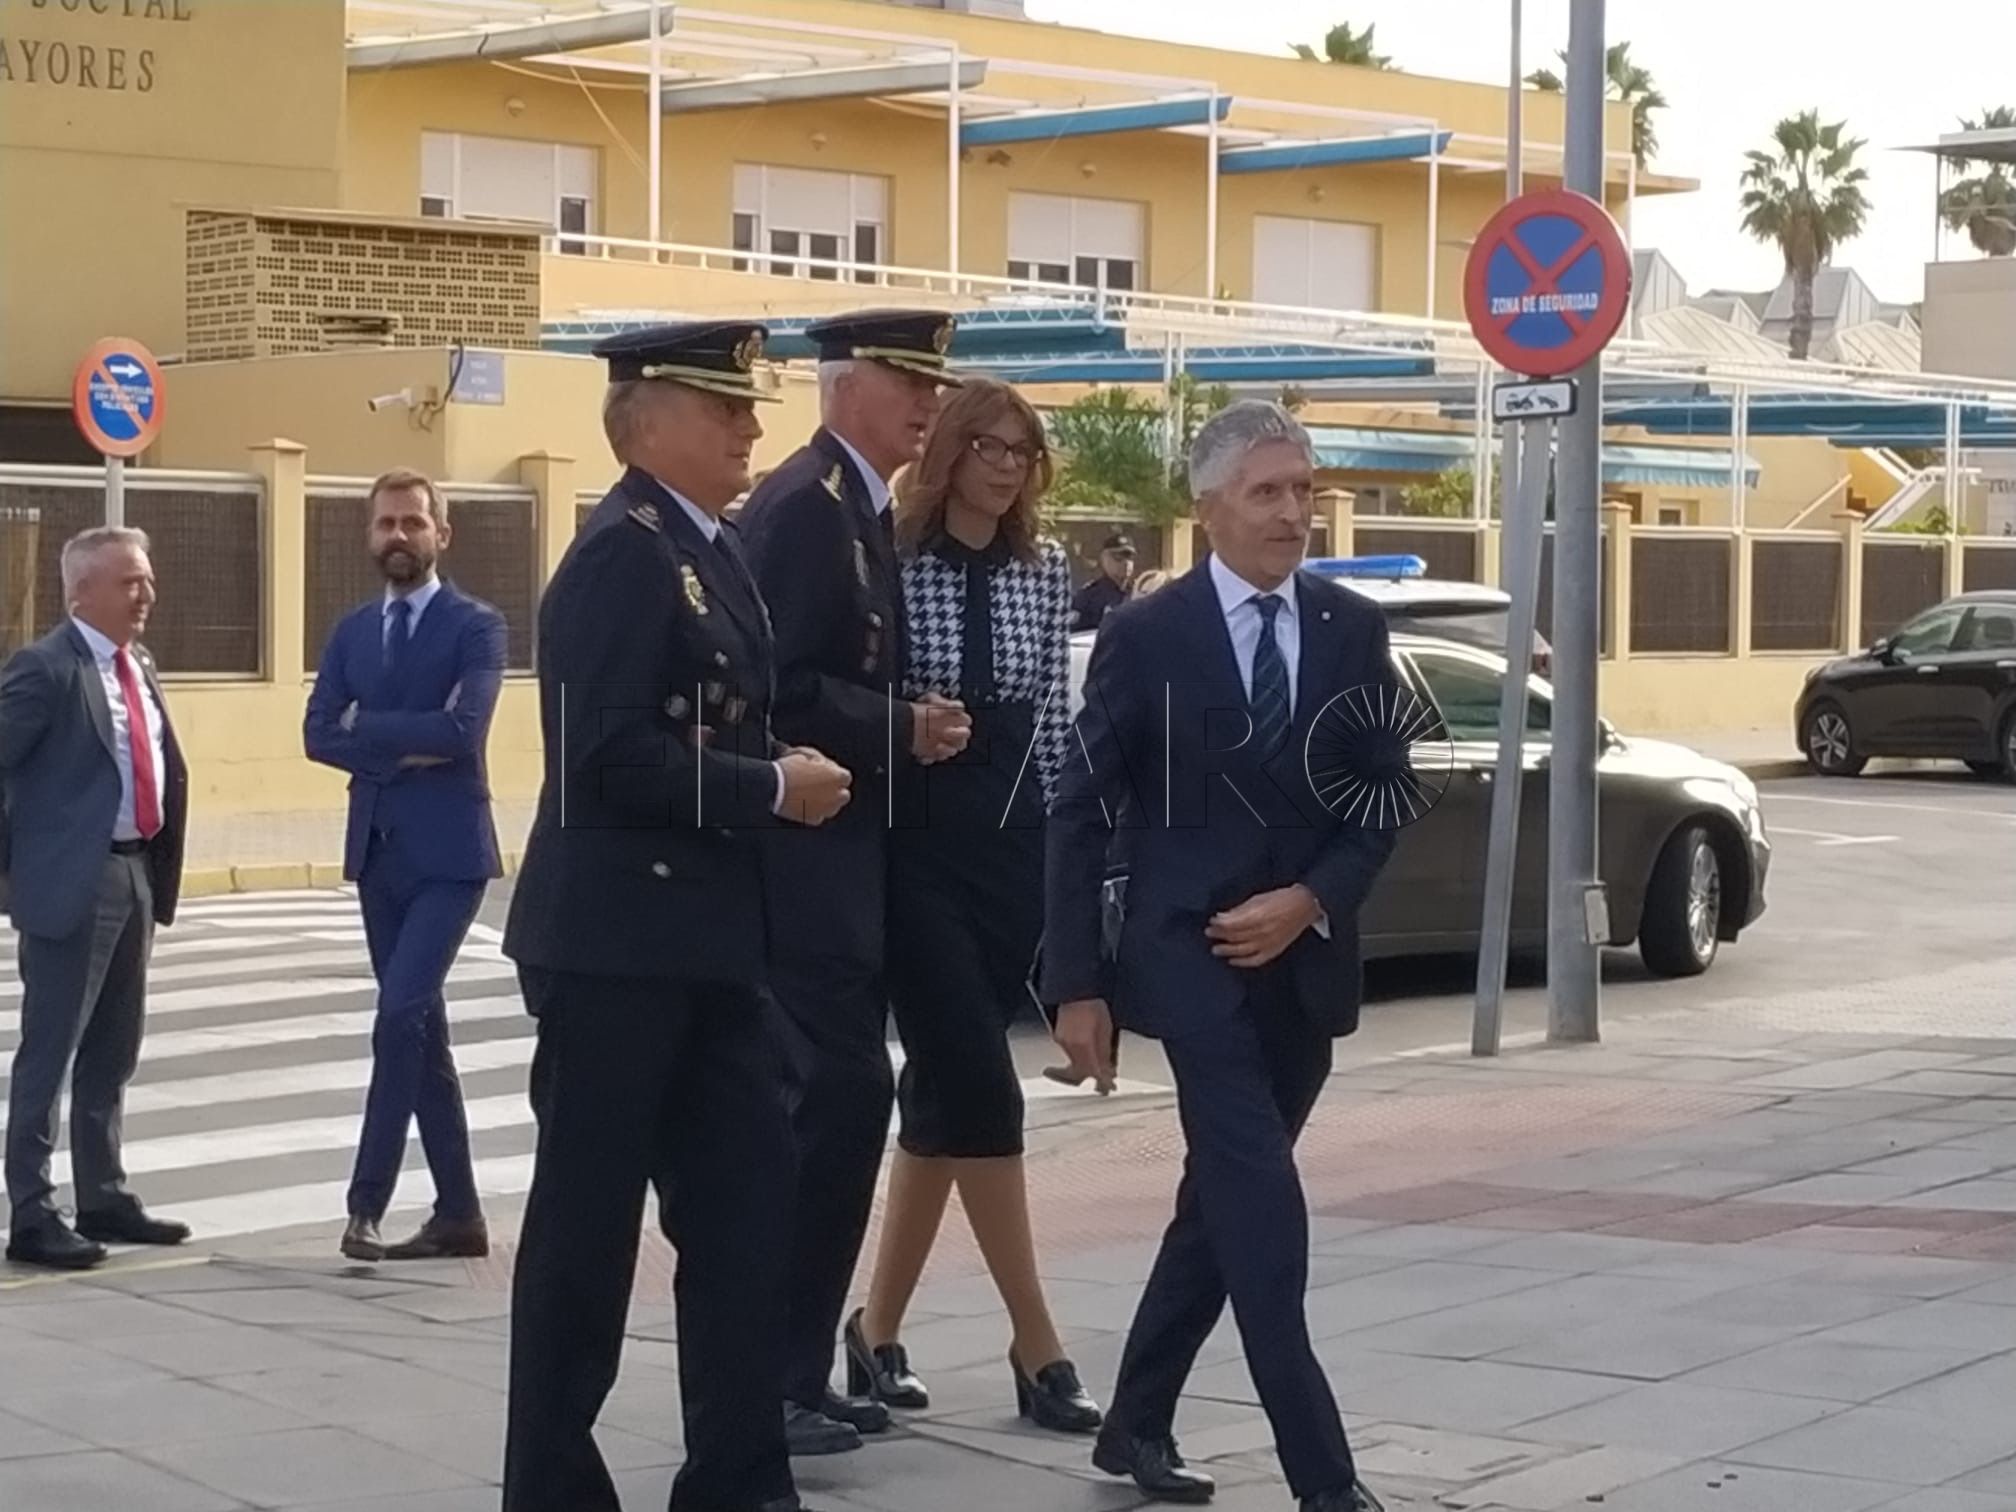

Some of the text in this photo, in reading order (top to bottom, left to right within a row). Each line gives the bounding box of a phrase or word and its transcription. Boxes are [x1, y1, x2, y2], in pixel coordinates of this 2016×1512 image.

[1491, 293, 1598, 315] ZONA DE SEGURIDAD
